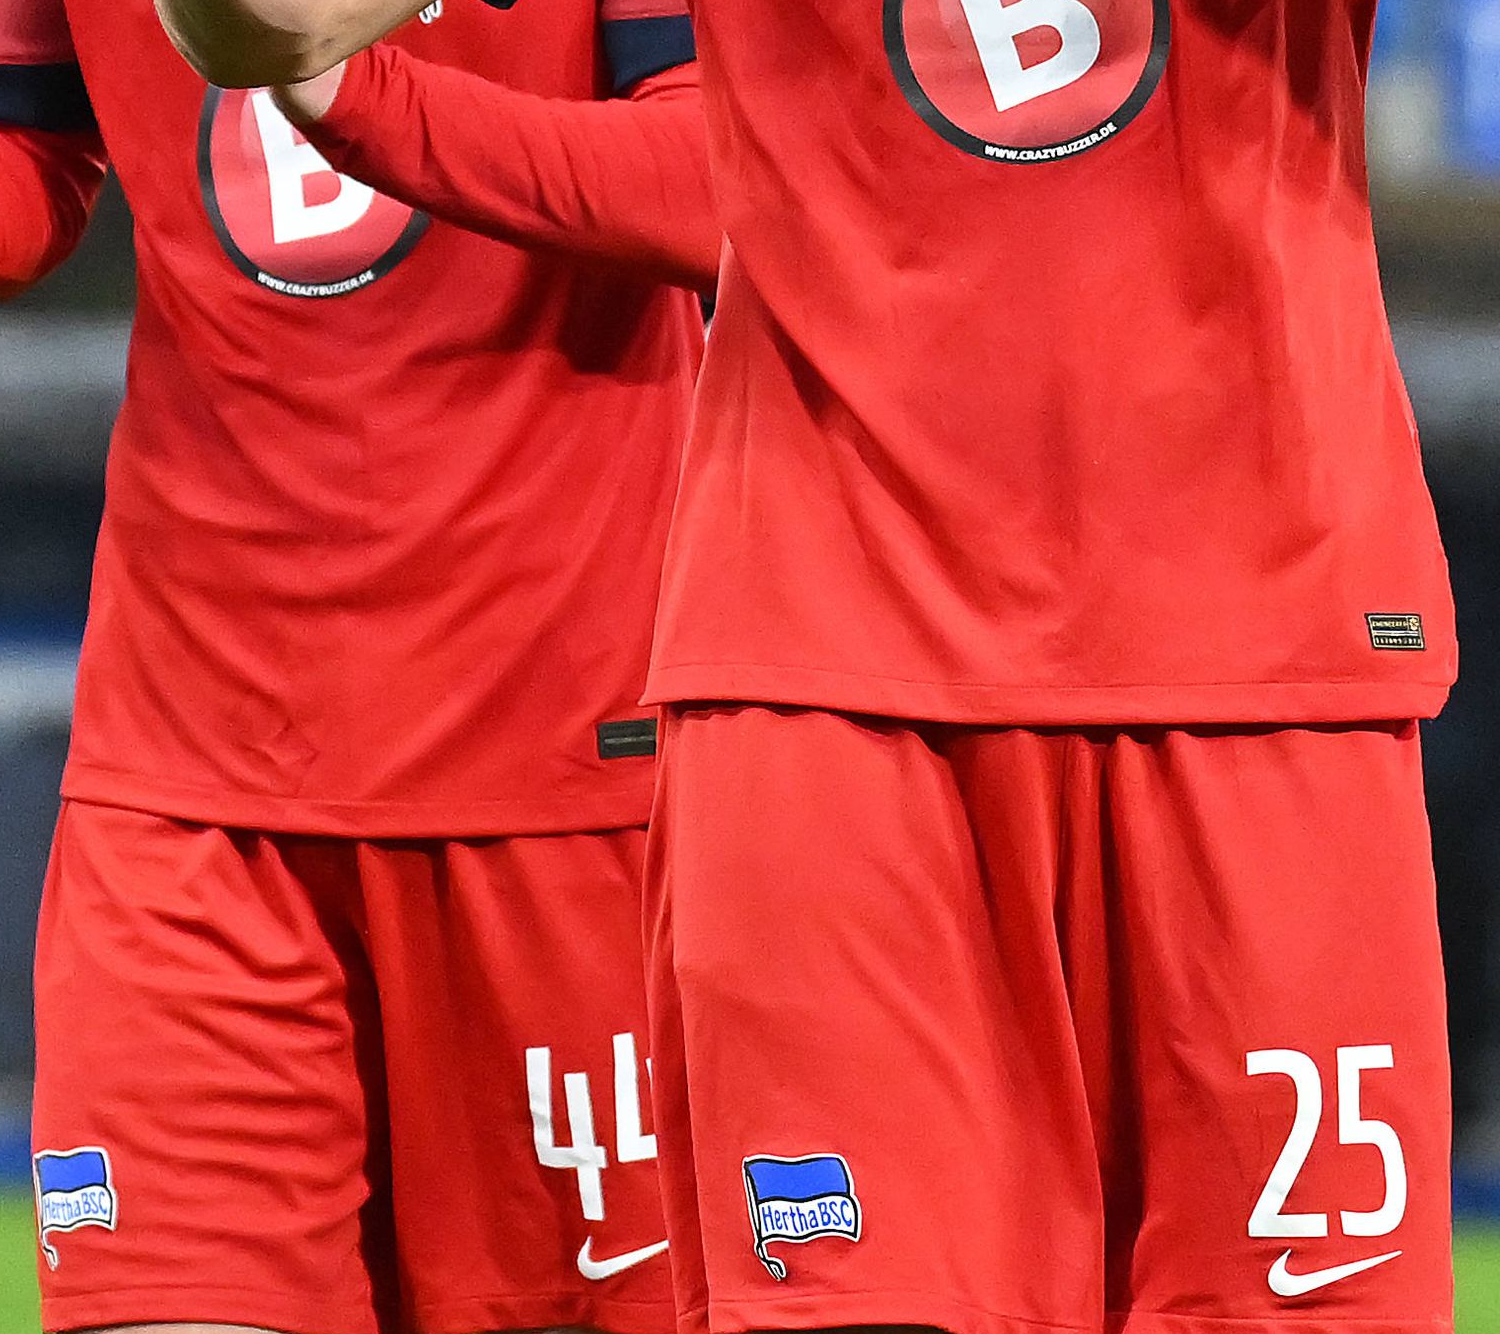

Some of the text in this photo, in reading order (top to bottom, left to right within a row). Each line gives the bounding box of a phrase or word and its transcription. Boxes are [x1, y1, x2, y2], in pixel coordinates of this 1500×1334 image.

[251, 90, 375, 244] B
[984, 121, 1118, 161] WWW.CRAZYBUZZER.DE
[1244, 1044, 1408, 1239] 25
